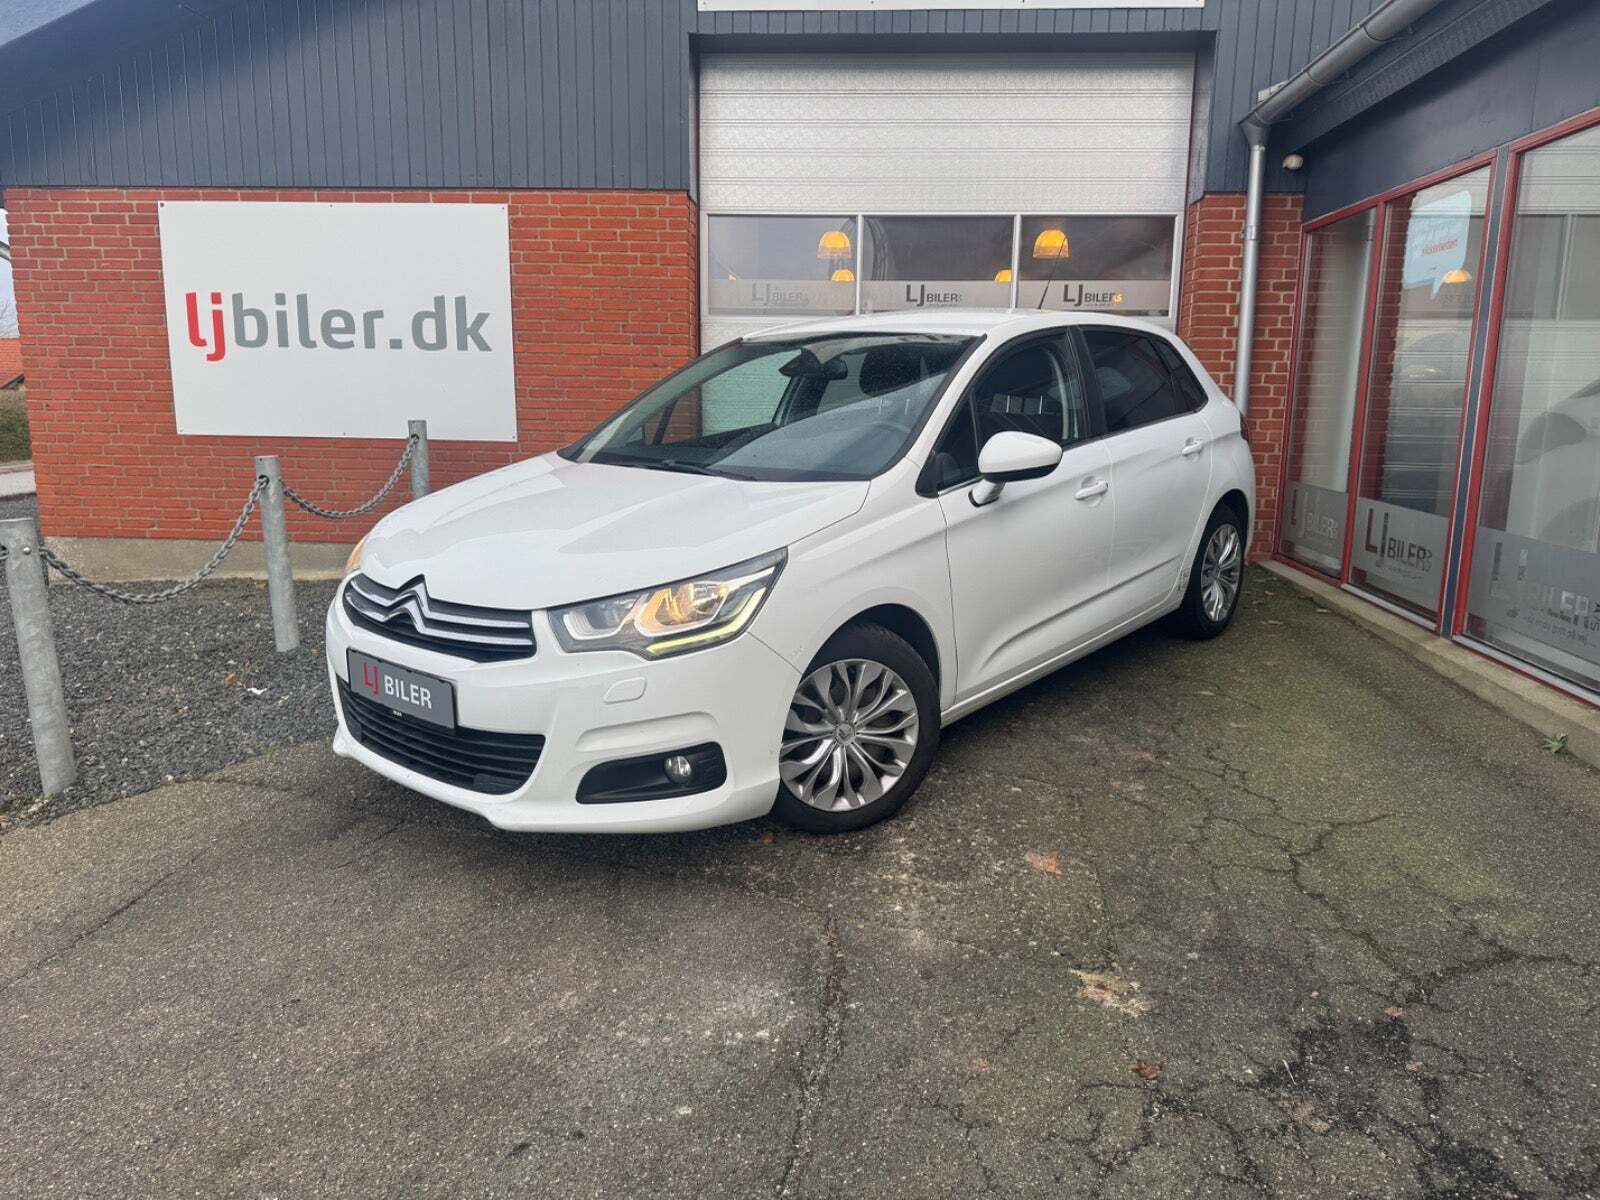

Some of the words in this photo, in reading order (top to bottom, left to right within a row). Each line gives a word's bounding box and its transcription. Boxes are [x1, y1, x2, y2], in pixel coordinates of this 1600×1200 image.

[906, 284, 925, 307] LJ
[926, 292, 959, 303] BILER
[1063, 284, 1083, 307] LJ
[185, 291, 492, 361] ljbiler.dk
[362, 660, 380, 697] LJ
[383, 673, 433, 709] BILER
